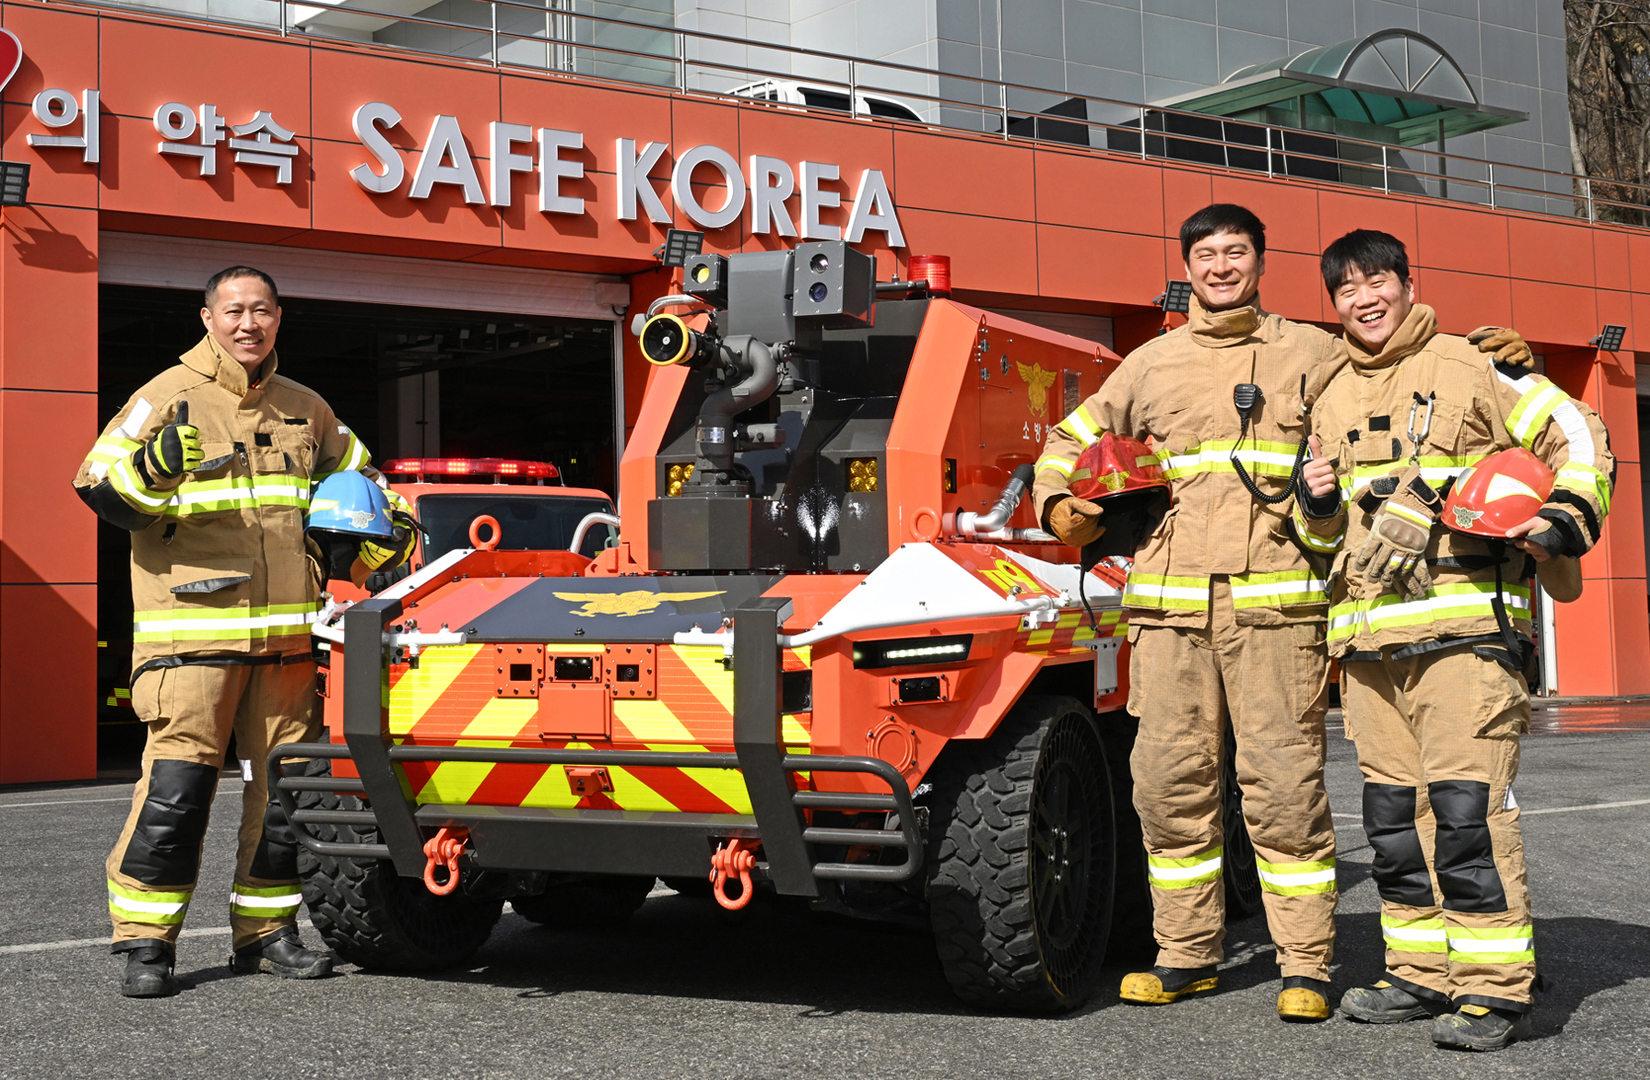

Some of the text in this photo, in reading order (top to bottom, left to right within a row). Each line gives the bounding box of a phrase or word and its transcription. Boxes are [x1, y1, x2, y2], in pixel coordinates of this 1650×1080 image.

[27, 88, 298, 183] 의 약속
[350, 101, 906, 247] SAFE KOREA
